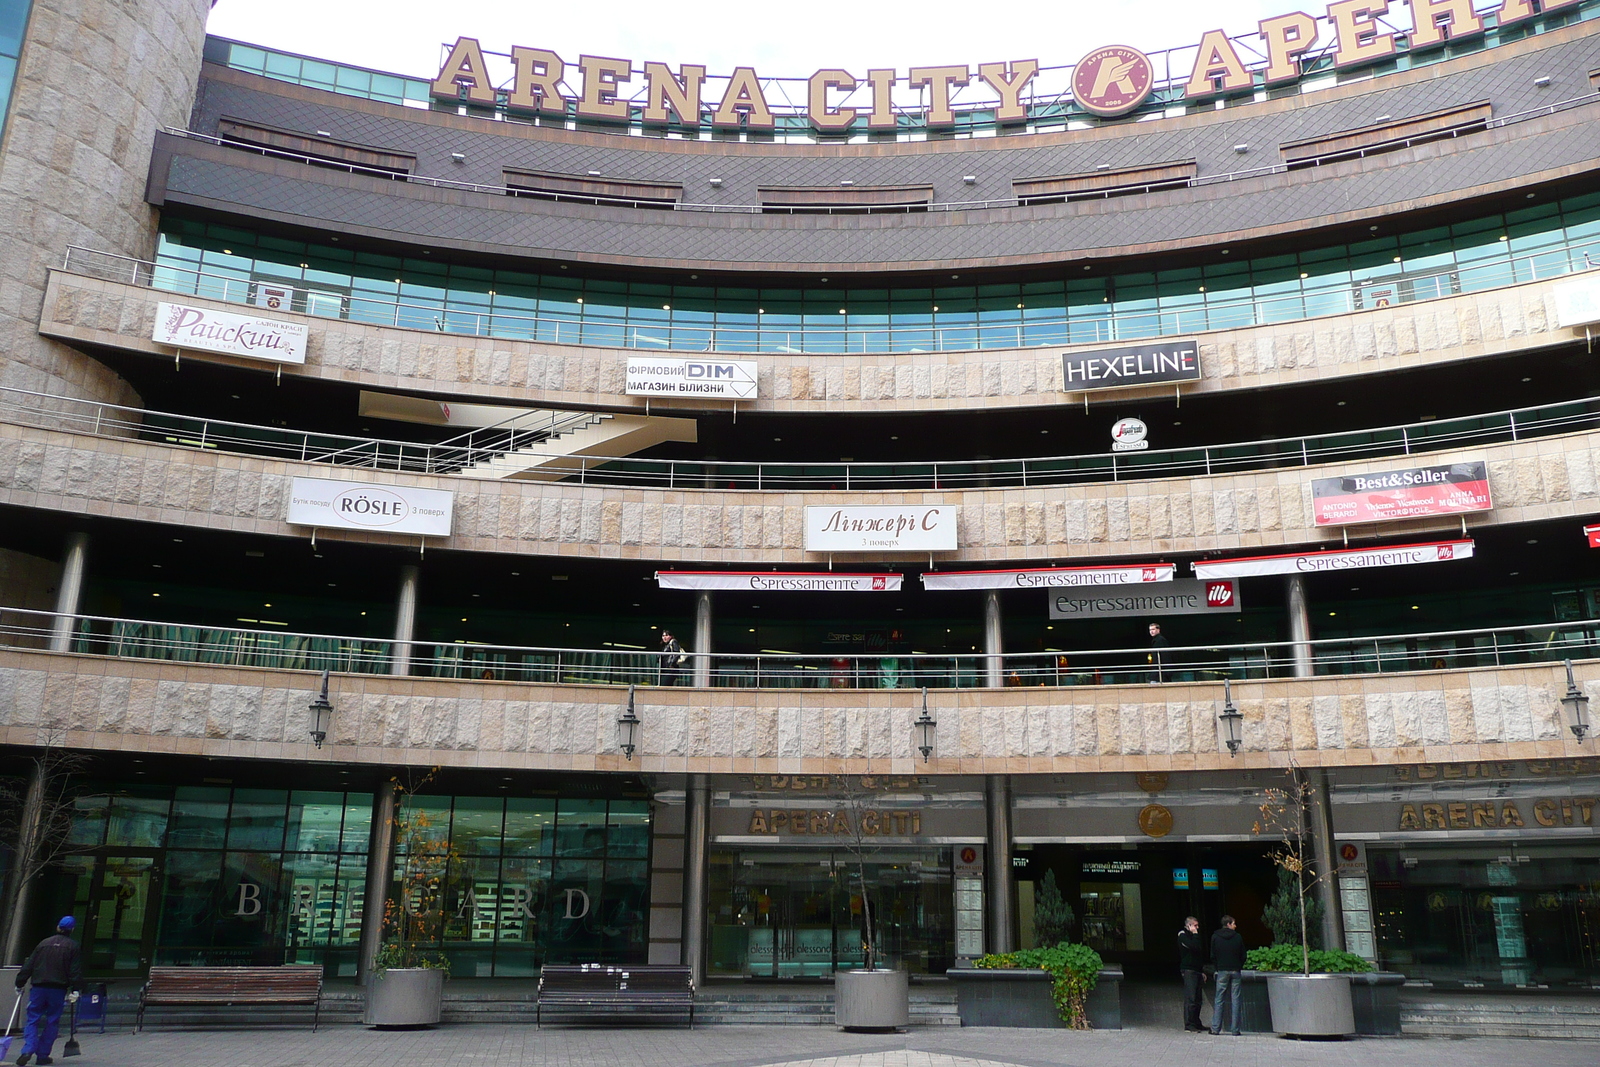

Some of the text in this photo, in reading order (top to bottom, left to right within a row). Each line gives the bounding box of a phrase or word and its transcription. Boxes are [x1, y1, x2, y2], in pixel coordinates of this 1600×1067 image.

[430, 36, 1039, 133] ARENA CITY
[173, 308, 283, 350] Райский
[280, 323, 303, 332] КРАСИ
[628, 364, 734, 379] ФІРМОВИЙ DIM
[1067, 350, 1195, 382] HEXELINE
[627, 381, 724, 393] МАГАЗИН БІЛИЗНИ
[1354, 469, 1449, 491] Best&Seller
[1438, 495, 1487, 507] MOLINARI
[1449, 490, 1474, 499] ANNA
[292, 497, 331, 508] Бутік посуду
[341, 495, 402, 516] RÖSLE
[1322, 502, 1357, 512] ANTONIO
[1364, 497, 1434, 511] Vivienne Westwood
[412, 506, 445, 517] 3 поверх
[1323, 510, 1358, 520] BERARDI
[821, 509, 916, 538] Лінжері
[861, 538, 900, 548] 3 поверх
[1437, 546, 1452, 559] illy
[1143, 569, 1156, 581] illy
[872, 577, 885, 590] illy
[1208, 584, 1231, 604] illy
[1400, 797, 1600, 831] ARENA CIT
